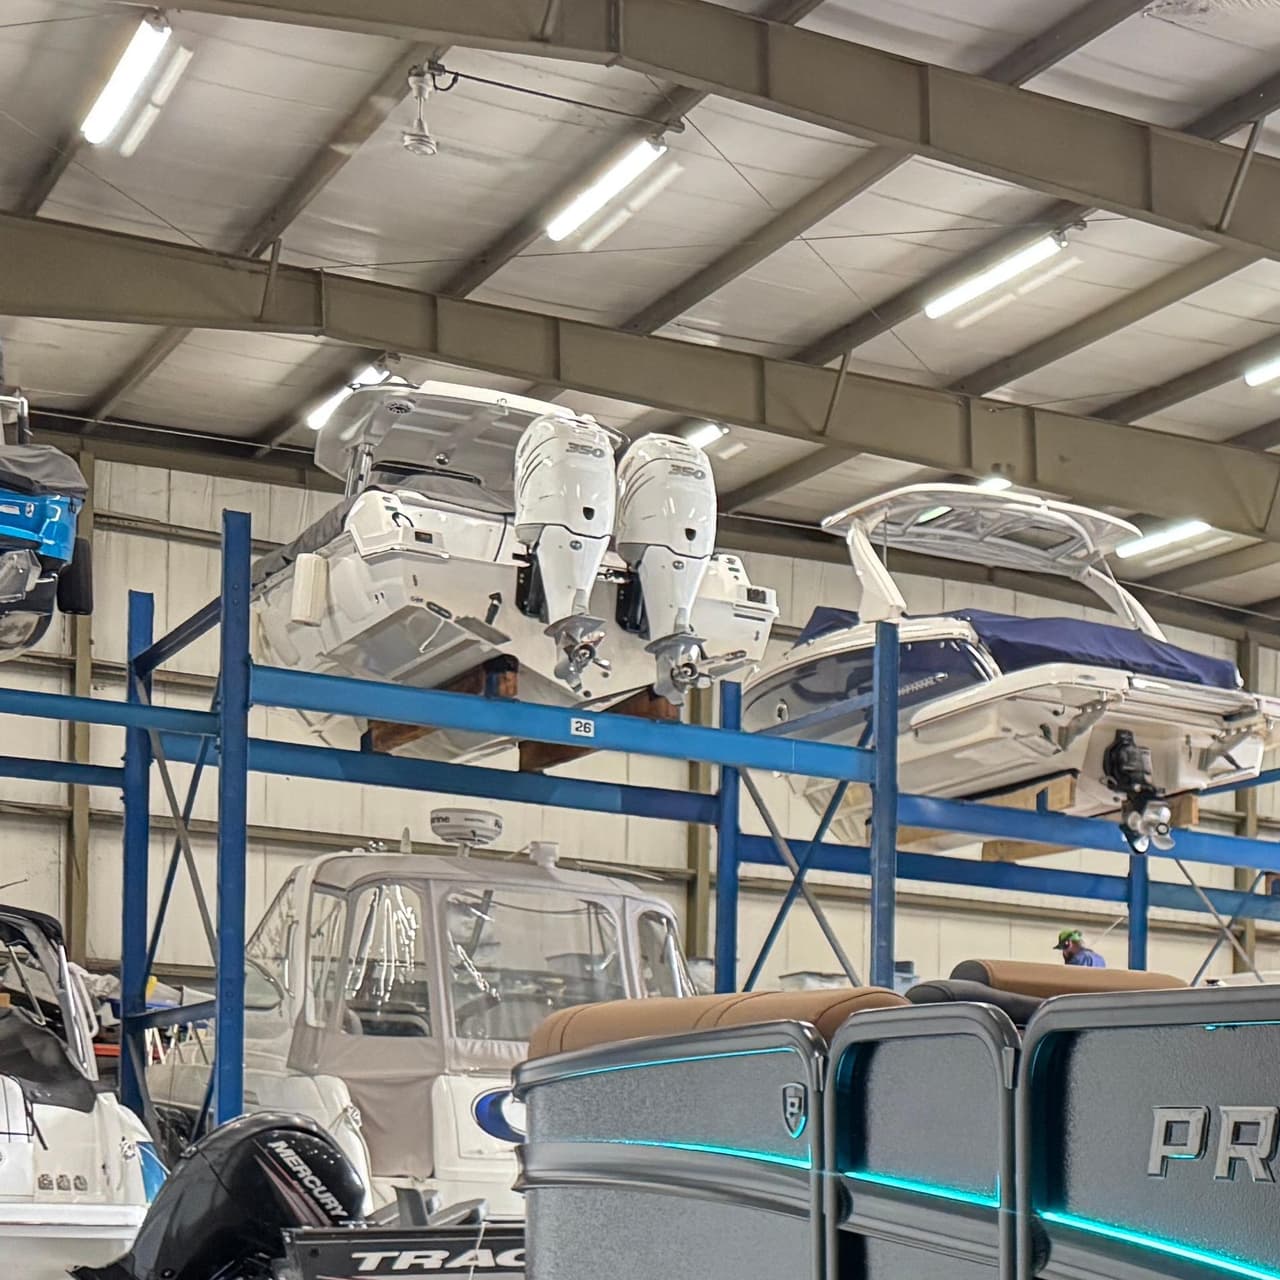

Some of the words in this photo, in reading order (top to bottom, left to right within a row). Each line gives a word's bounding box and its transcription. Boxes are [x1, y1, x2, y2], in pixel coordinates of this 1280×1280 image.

[566, 441, 605, 458] 350
[668, 464, 706, 480] 350
[575, 720, 592, 733] 26
[267, 1140, 349, 1217] MERCURY
